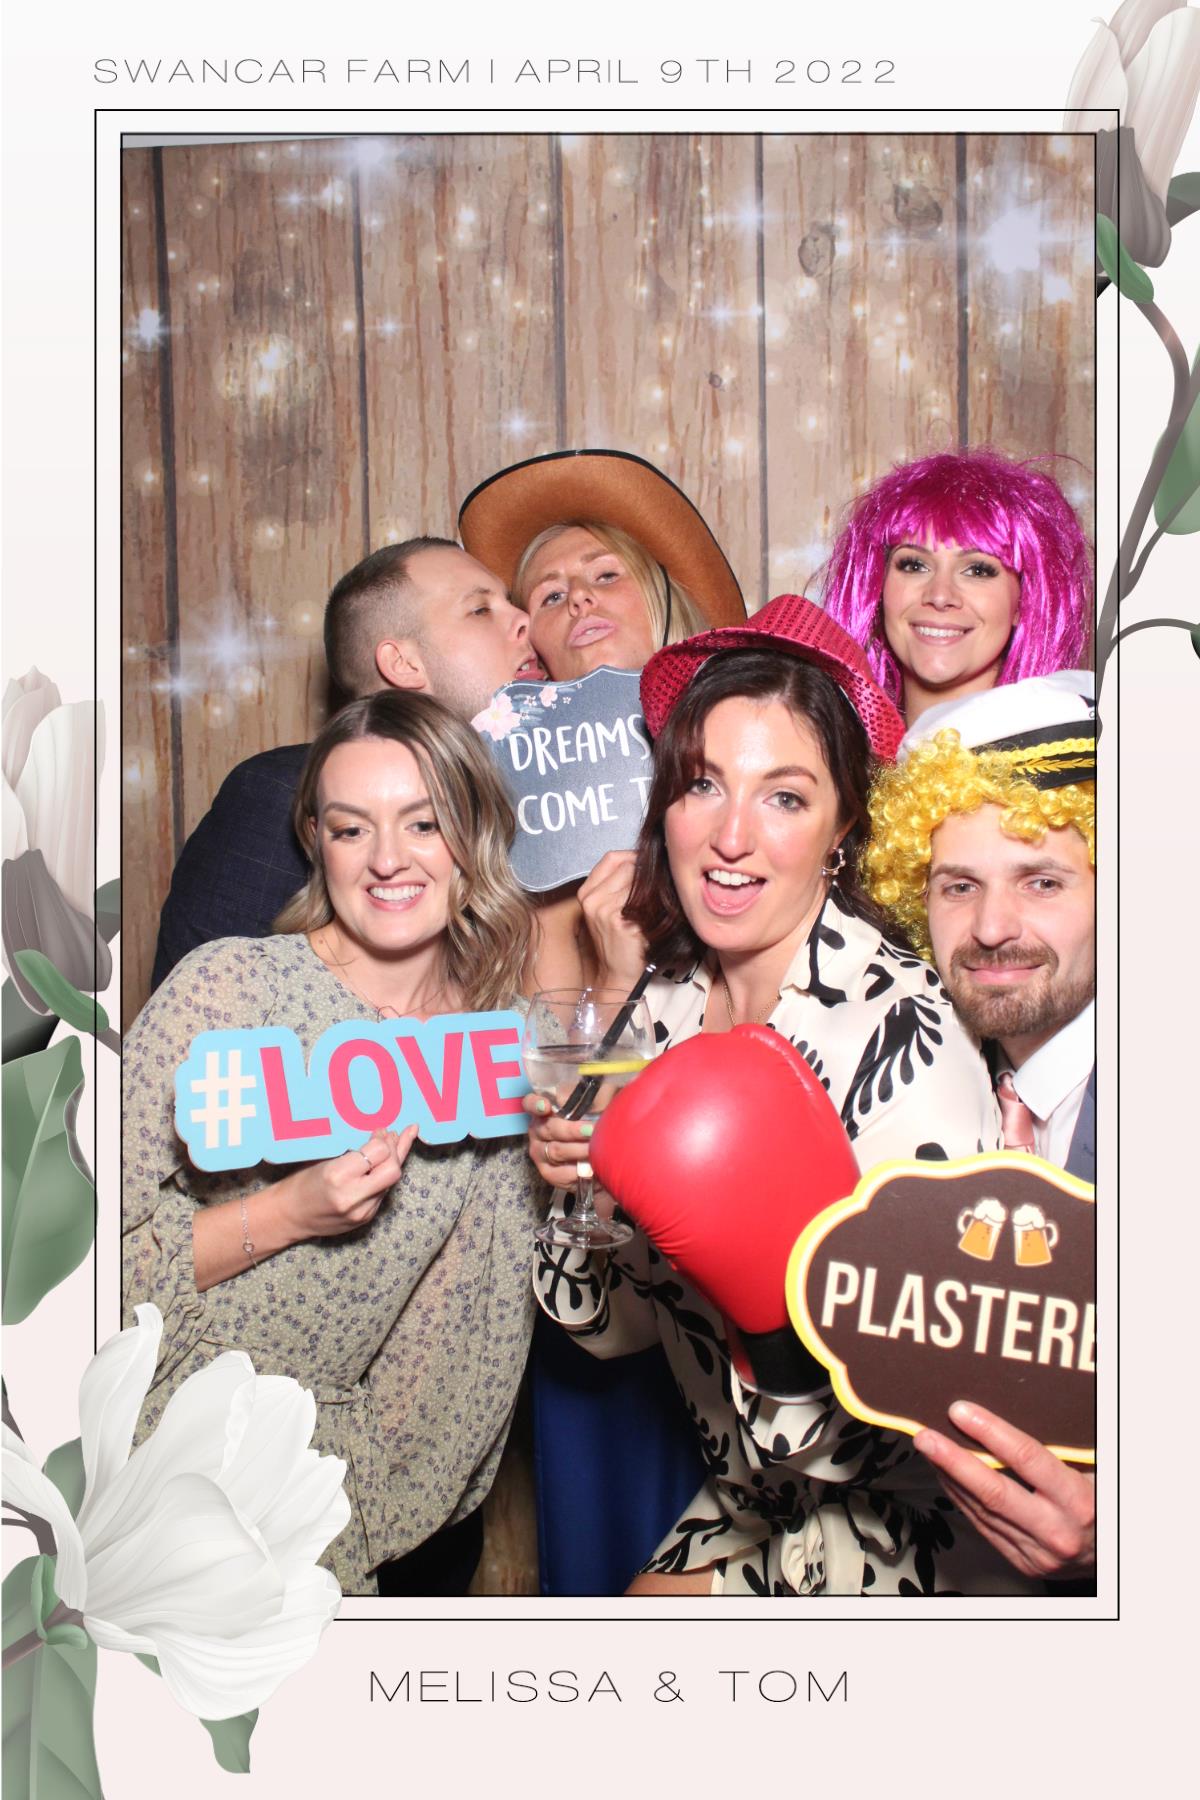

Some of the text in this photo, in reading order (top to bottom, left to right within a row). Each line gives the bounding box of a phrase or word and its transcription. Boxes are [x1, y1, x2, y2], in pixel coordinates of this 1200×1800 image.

[508, 714, 651, 775] DREAMS
[517, 784, 619, 835] COME
[190, 1027, 525, 1149] #LOVE
